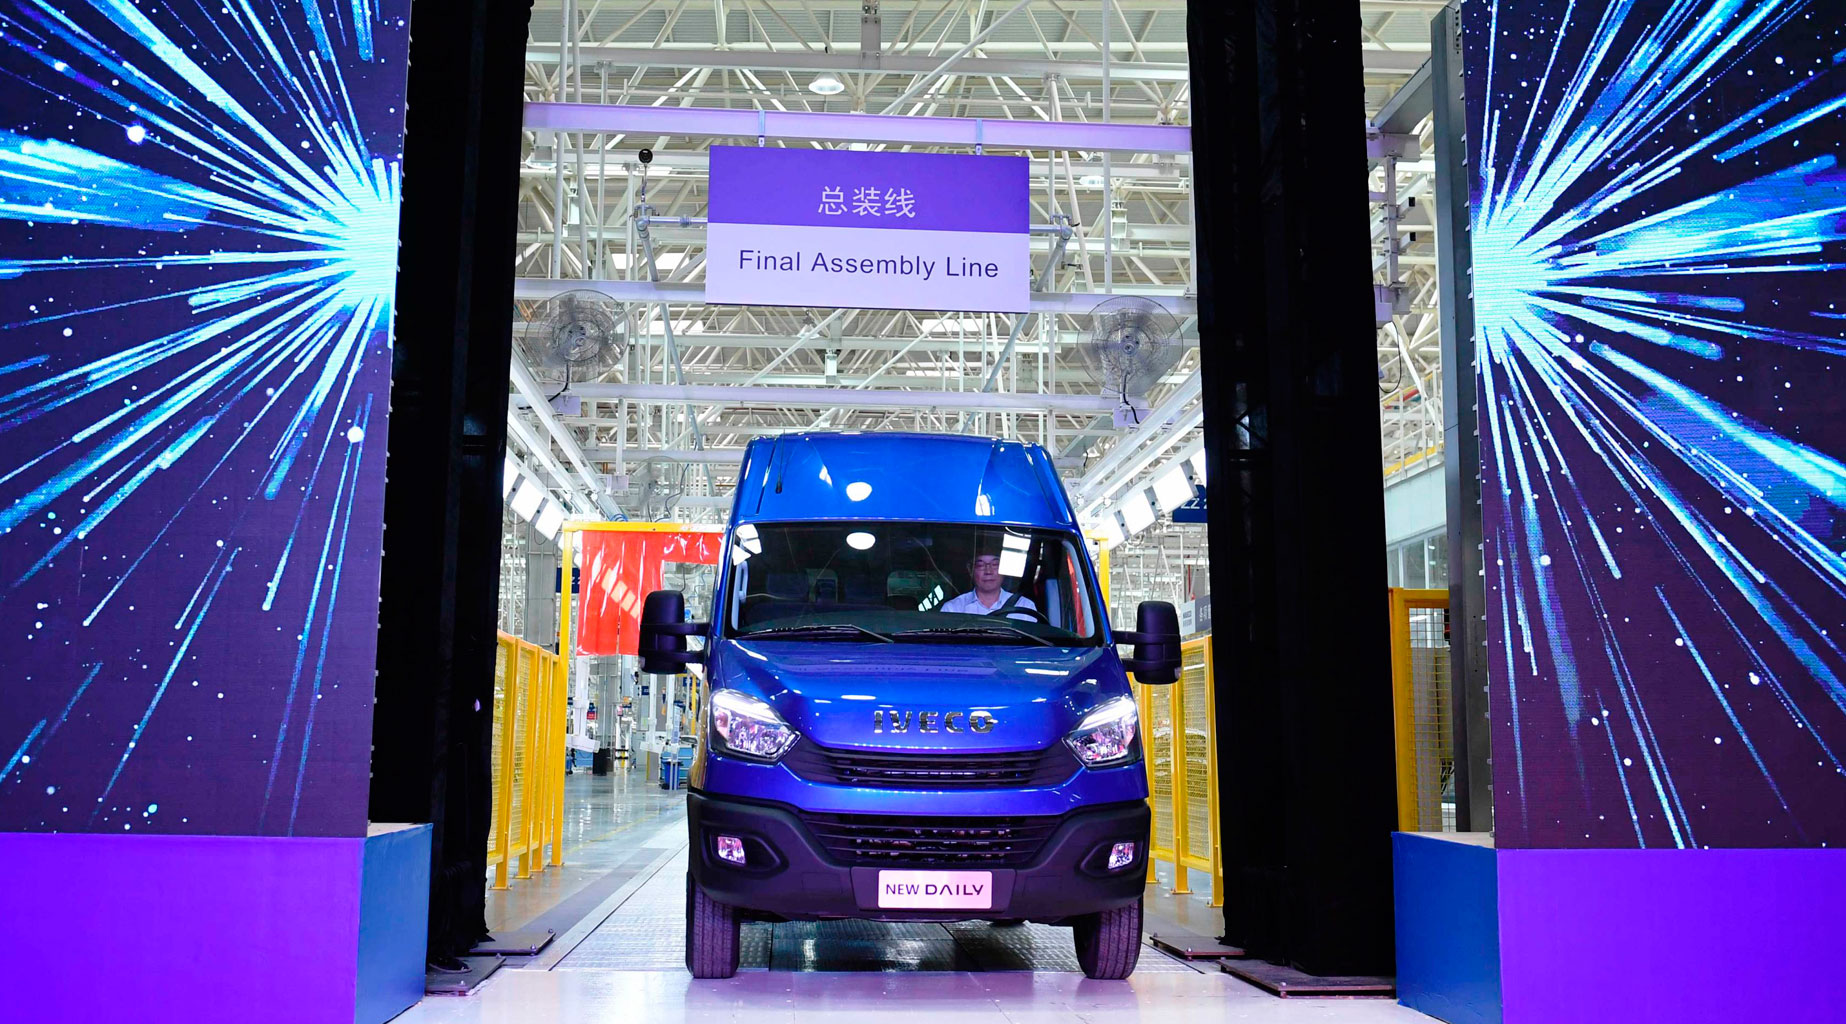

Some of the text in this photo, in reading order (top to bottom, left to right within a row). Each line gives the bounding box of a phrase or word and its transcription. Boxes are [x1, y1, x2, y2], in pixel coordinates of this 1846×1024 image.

[817, 185, 917, 219] 总装线
[739, 249, 999, 281] Final Assembly Line
[873, 709, 997, 734] IVECO
[885, 883, 984, 896] NEW DAILY
